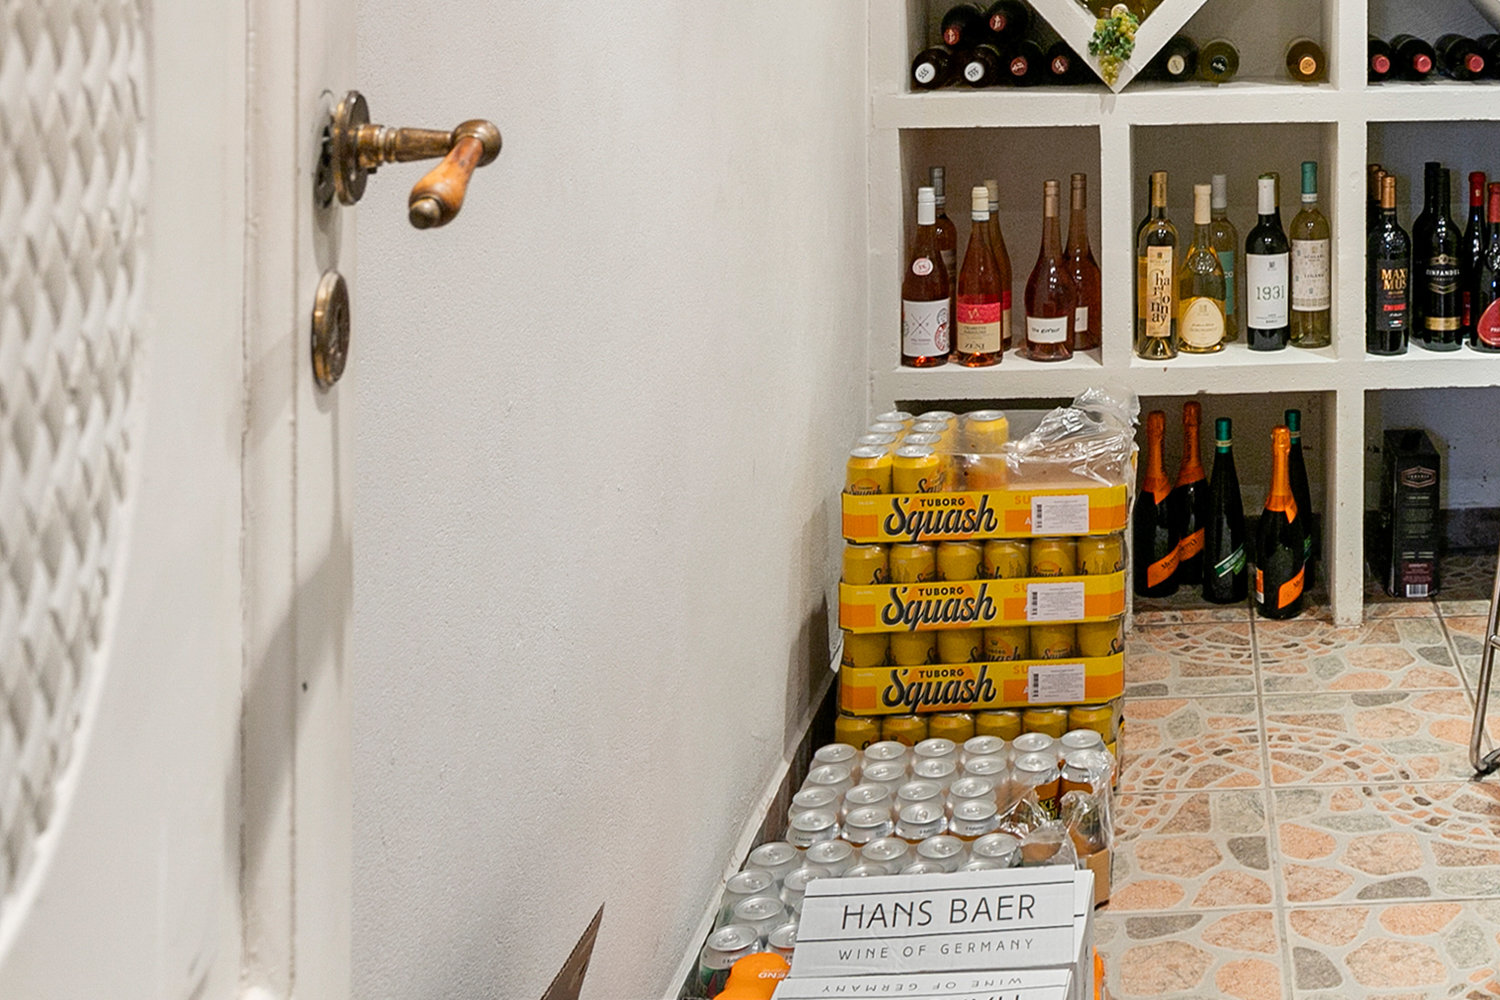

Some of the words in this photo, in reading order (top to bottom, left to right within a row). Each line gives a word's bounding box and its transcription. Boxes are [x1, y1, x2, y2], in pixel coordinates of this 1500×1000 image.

[1256, 285, 1285, 301] 1931
[920, 497, 966, 507] TUBORG
[883, 494, 999, 542] Squash
[917, 587, 965, 597] TUBORG
[881, 583, 997, 632] Squash
[918, 668, 965, 679] TUBORG
[881, 665, 997, 713] Squash
[841, 898, 933, 930] HANS
[949, 893, 1036, 924] BAER
[838, 946, 889, 961] WINE
[902, 943, 926, 958] OF
[939, 937, 1035, 955] GERMANY
[822, 982, 918, 993] GERMANY
[933, 981, 957, 990] OF
[971, 977, 1022, 988] WINE
